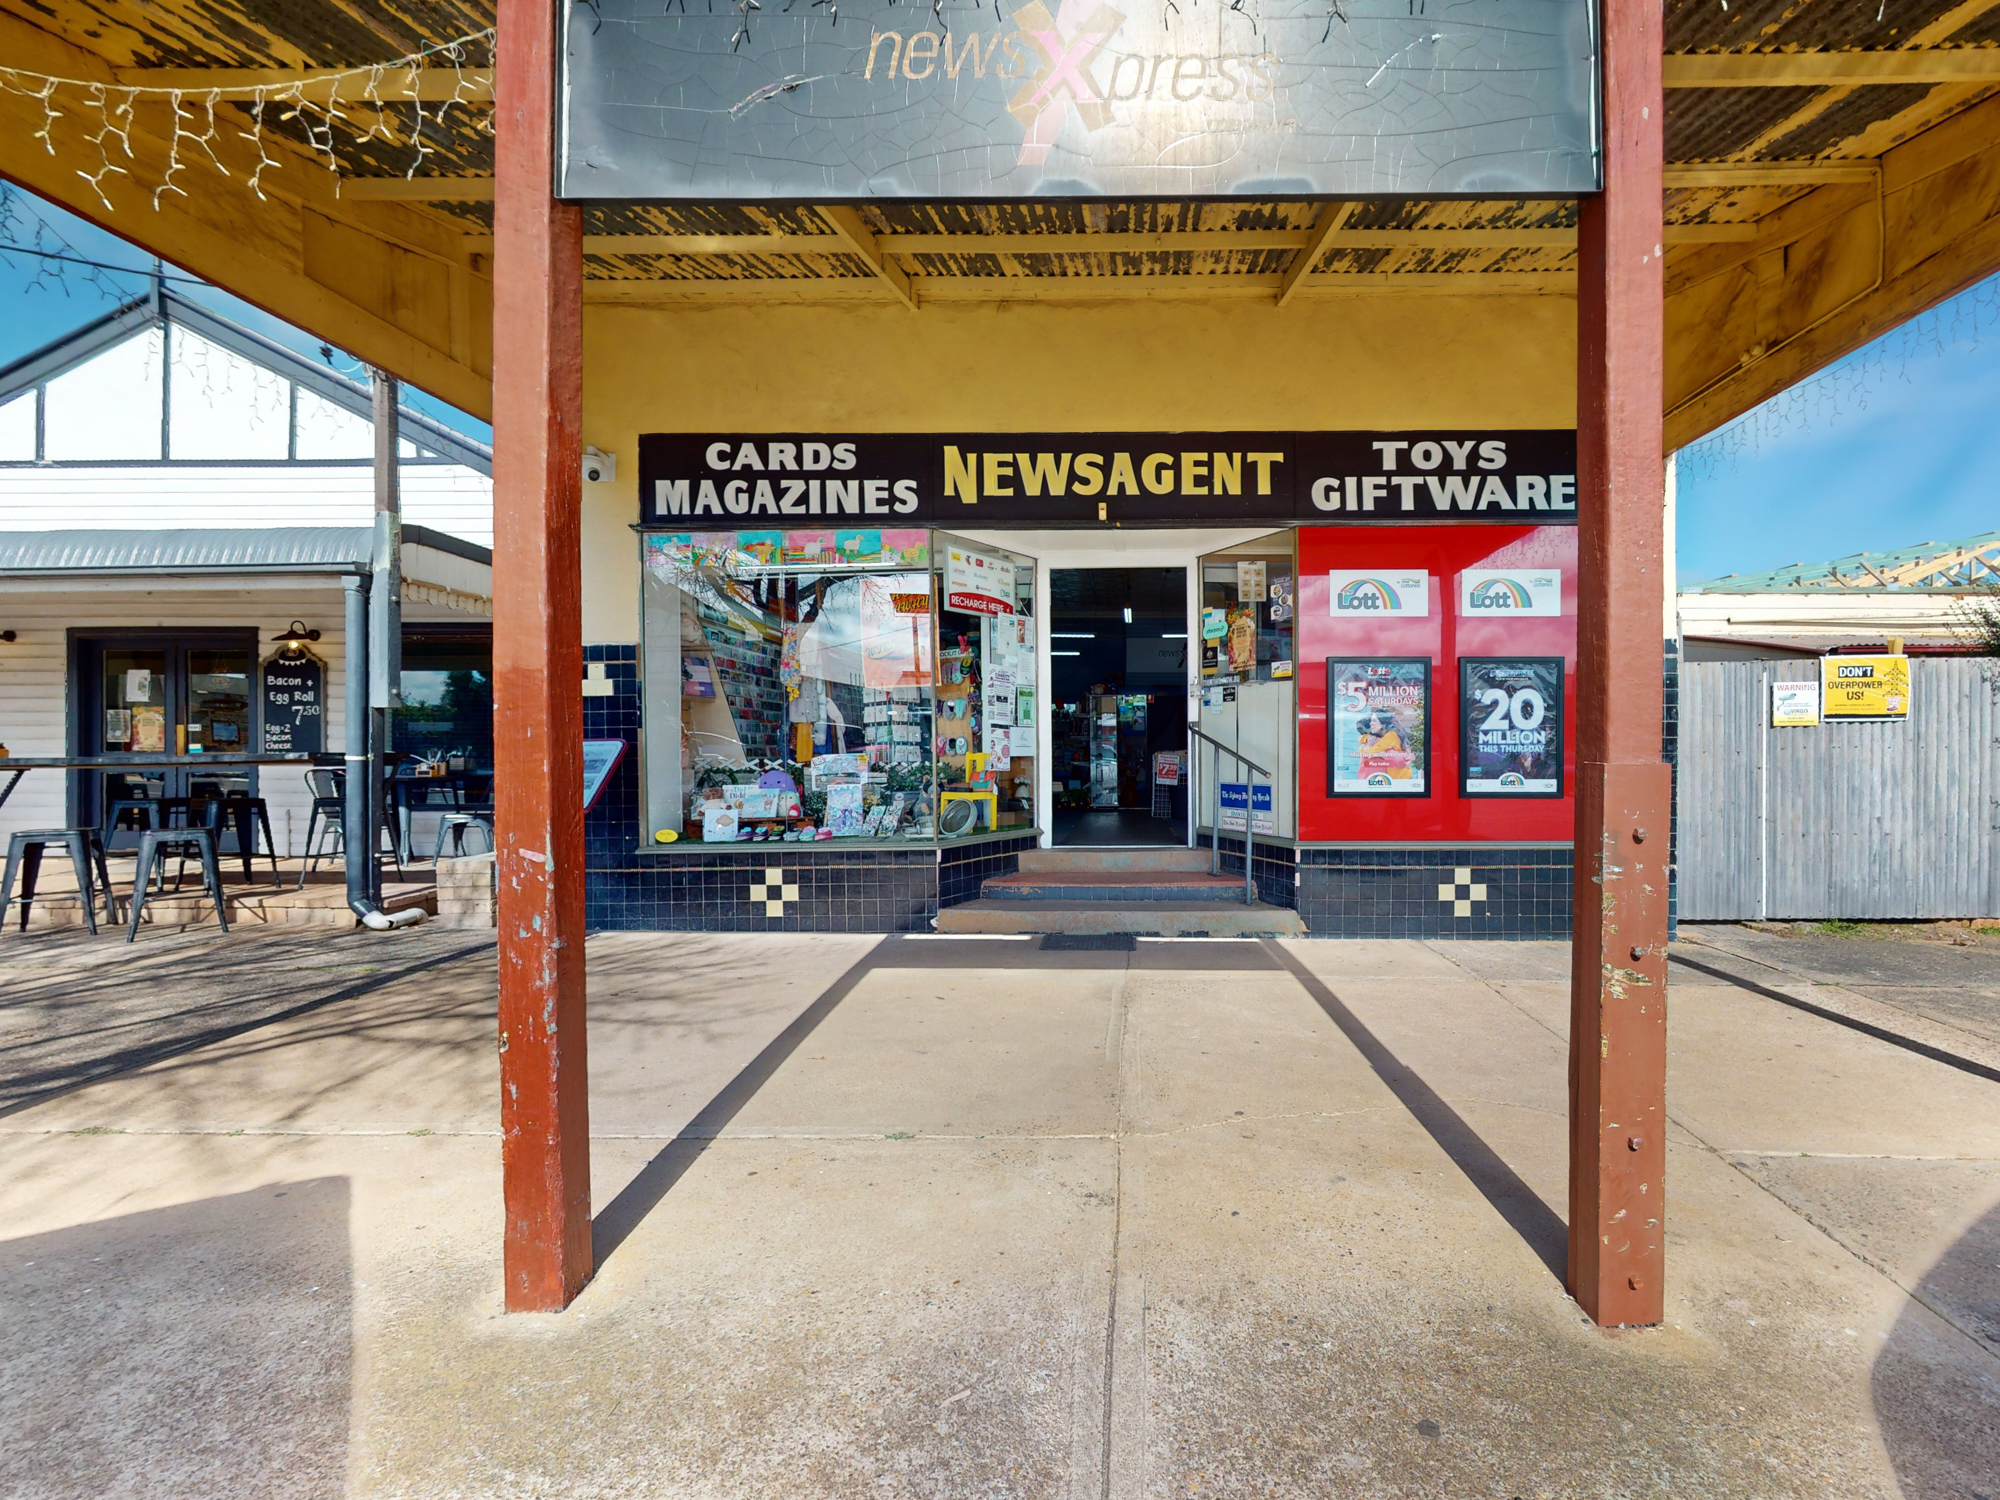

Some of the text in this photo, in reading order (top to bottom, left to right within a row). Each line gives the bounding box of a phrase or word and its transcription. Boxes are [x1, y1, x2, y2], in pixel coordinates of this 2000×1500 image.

[705, 442, 857, 471] CARDS
[1372, 440, 1508, 470] TOYS
[943, 445, 1284, 504] NEWSAGENT
[655, 479, 919, 515] MAGAZINES
[1310, 475, 1576, 511] GIFTWARE
[951, 595, 1005, 613] RECHARGE HERE
[1338, 593, 1380, 609] Lott
[1470, 592, 1511, 608] Lott
[1839, 666, 1873, 677] DON'T
[267, 675, 302, 686] Bacon
[1828, 681, 1883, 689] OVERPOWER
[269, 691, 314, 705] Egg Roll
[1368, 697, 1419, 706] SATURDAYS
[1847, 691, 1864, 700] US!
[1479, 731, 1547, 744] MILLION
[1479, 745, 1546, 753] THIS THURSDAY
